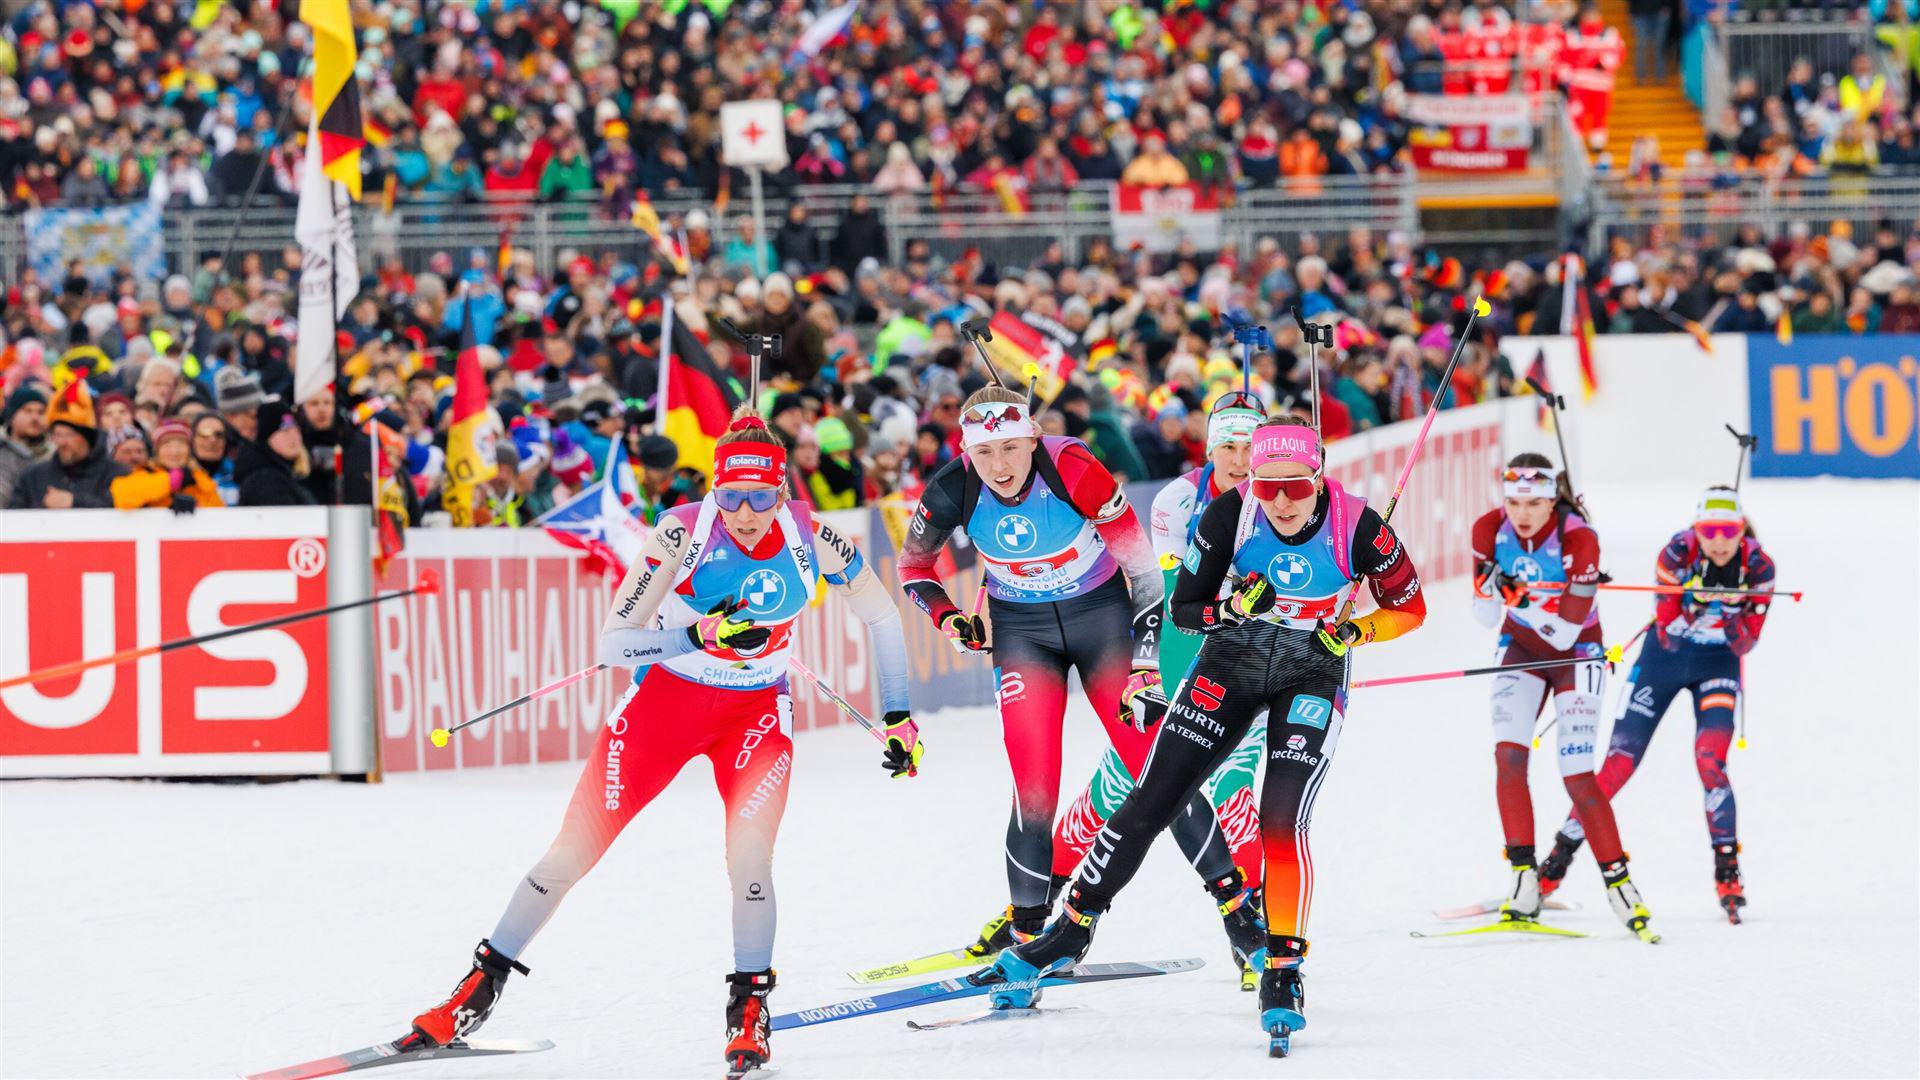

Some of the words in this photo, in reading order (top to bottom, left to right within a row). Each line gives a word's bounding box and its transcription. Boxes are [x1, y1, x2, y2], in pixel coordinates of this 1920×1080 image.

[1771, 355, 1920, 456] HÖ
[730, 456, 759, 466] Roland
[656, 534, 676, 558] odlo
[683, 543, 702, 570] JOKA
[820, 525, 854, 564] BKW
[792, 546, 810, 572] JOKA
[617, 572, 652, 619] helvetia
[1139, 614, 1159, 657] CAN
[379, 588, 611, 742] BAUHAU
[633, 647, 663, 657] Sunrise
[1171, 702, 1225, 737] WÜRTH
[735, 714, 778, 769] odlo
[1177, 725, 1215, 750] TERREX
[1271, 750, 1318, 766] tectake
[739, 750, 791, 821] RAIFFEISEN
[865, 963, 909, 981] FISCHER
[798, 996, 879, 1024] SALOMON
